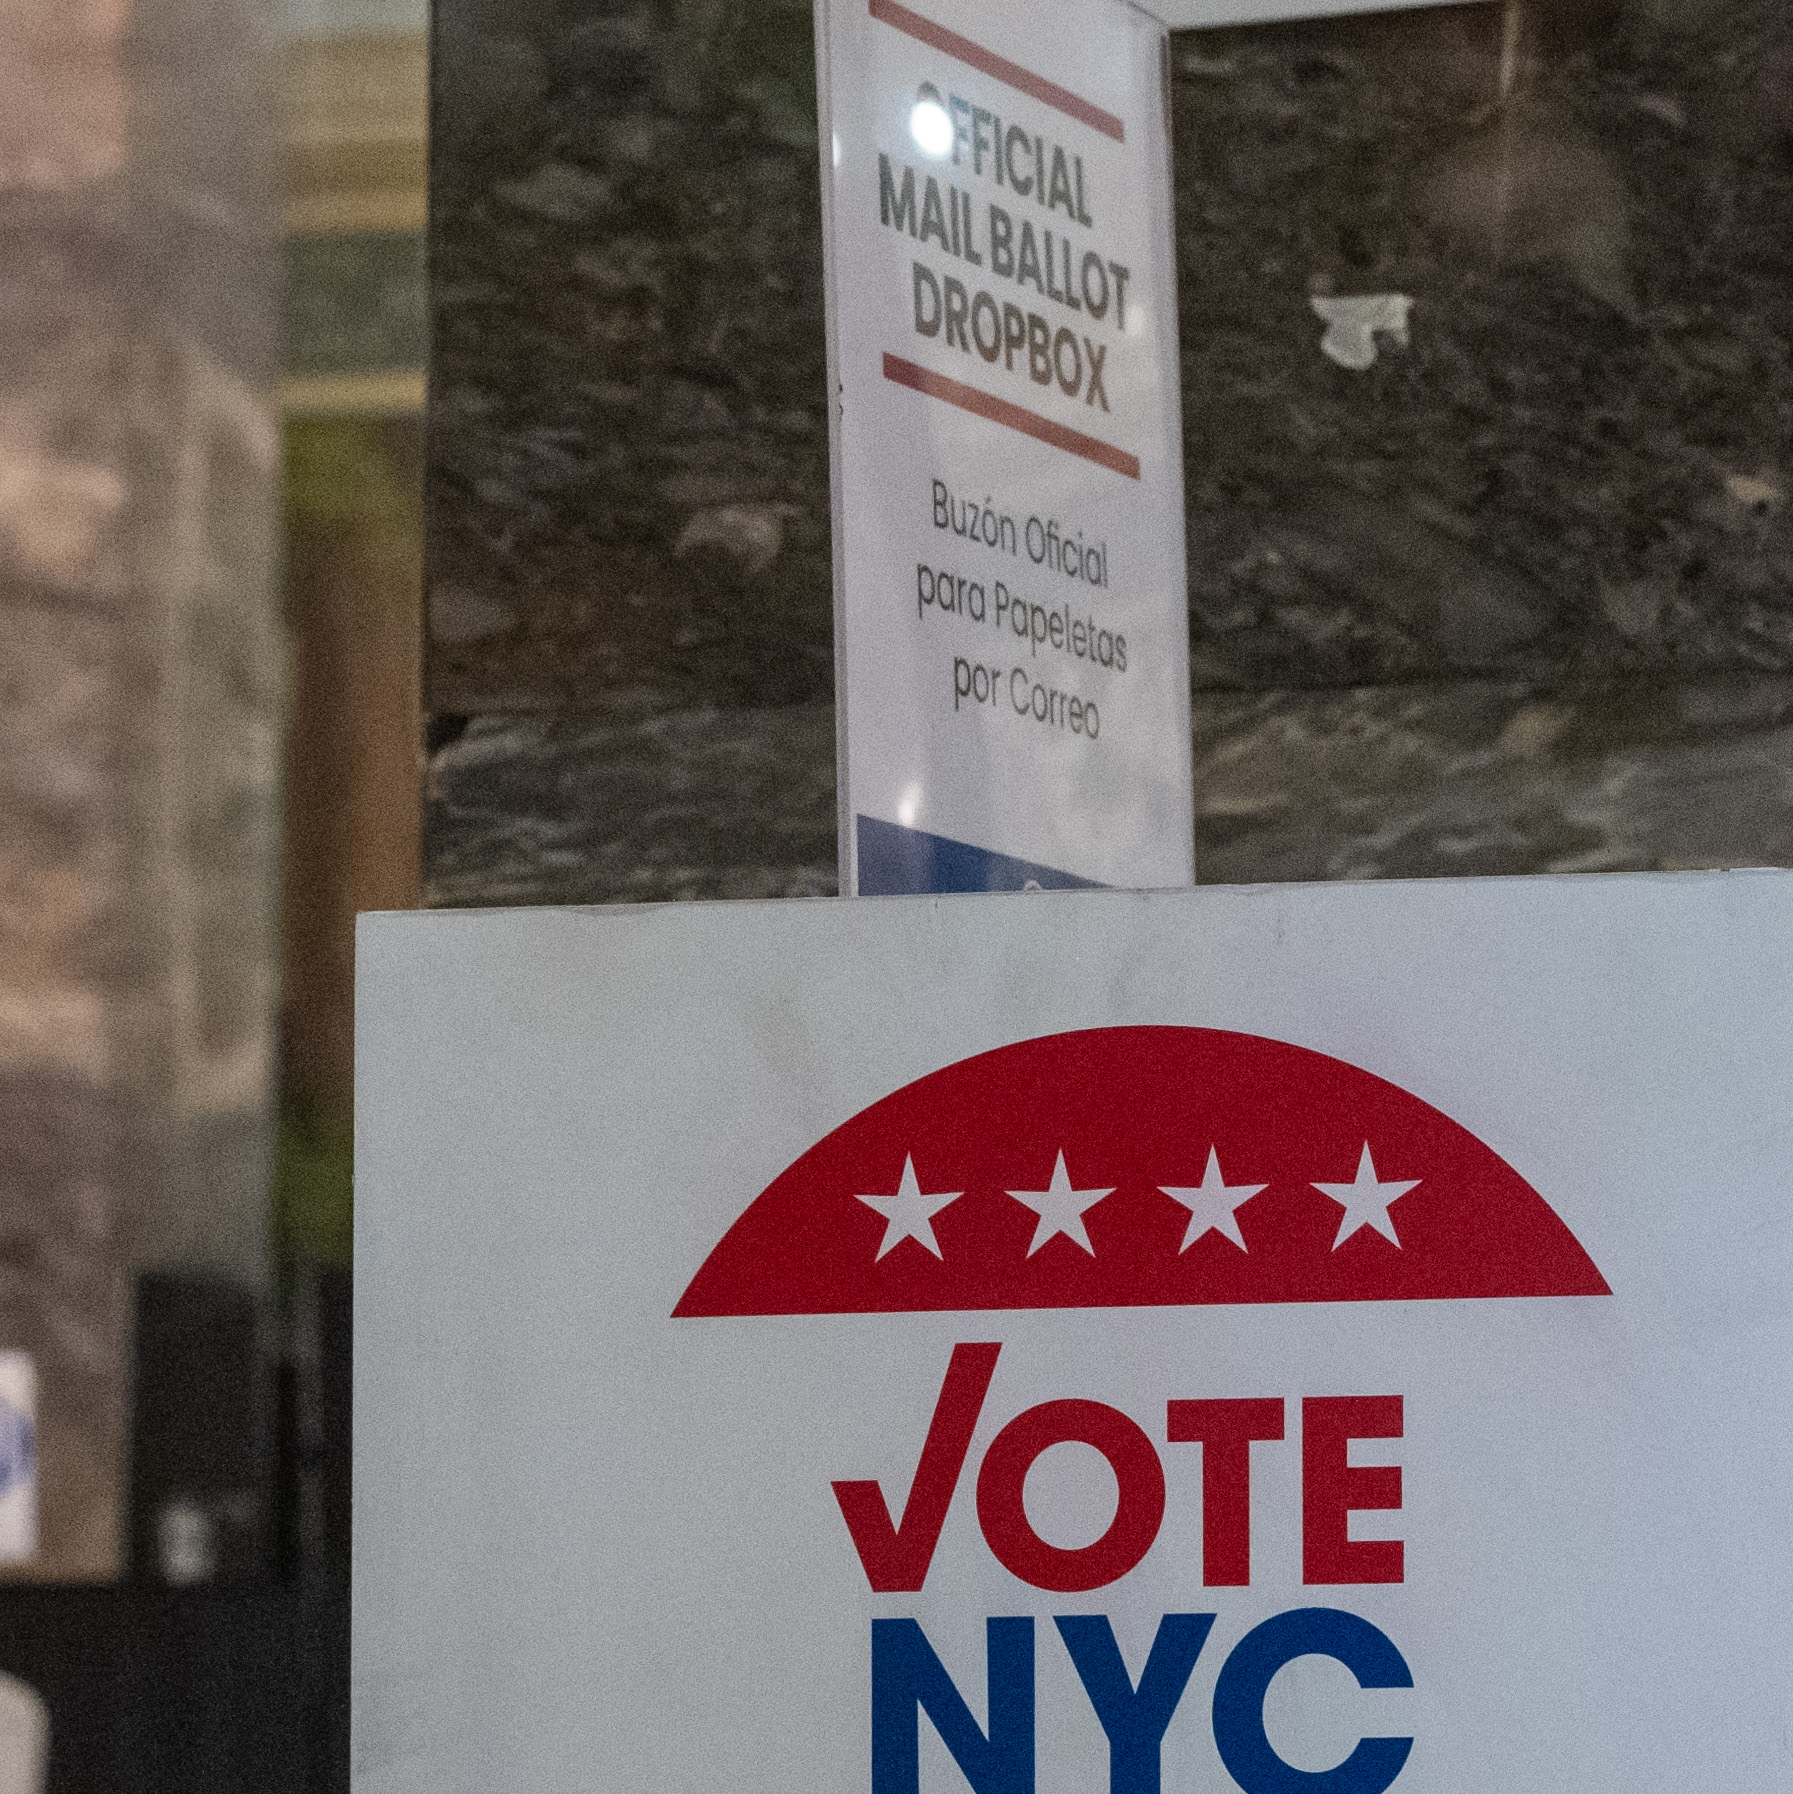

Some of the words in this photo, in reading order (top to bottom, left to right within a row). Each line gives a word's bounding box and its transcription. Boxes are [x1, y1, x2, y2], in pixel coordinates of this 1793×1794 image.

[878, 153, 982, 267] MAIL
[990, 203, 1130, 331] BALLOT
[912, 259, 1111, 413] DROPBOX
[931, 478, 1017, 556] Buzón
[1024, 515, 1109, 588] Oficial
[917, 562, 986, 622] para
[995, 580, 1128, 672] Papeletas
[953, 653, 1001, 711] por
[1008, 667, 1101, 739] Correo
[829, 1341, 1405, 1593] VOTE
